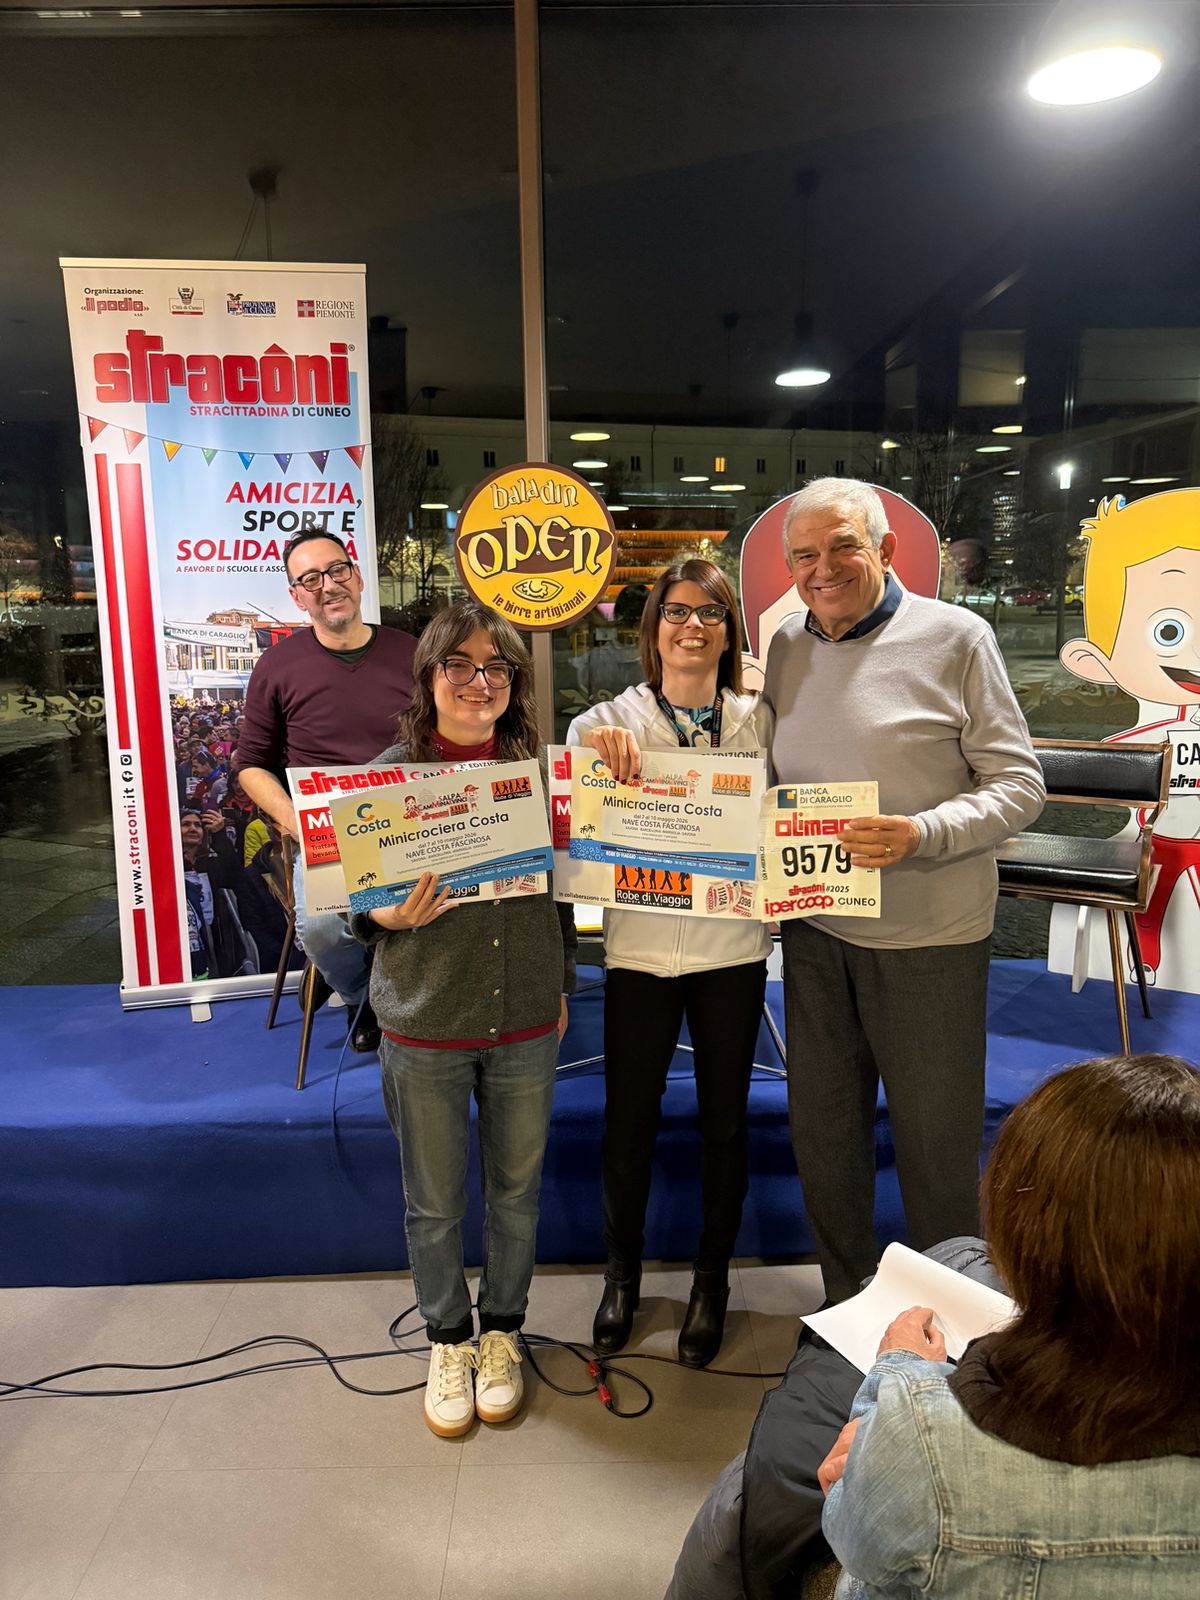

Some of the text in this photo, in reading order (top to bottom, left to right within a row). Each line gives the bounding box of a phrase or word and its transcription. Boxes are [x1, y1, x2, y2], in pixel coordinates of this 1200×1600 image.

[84, 287, 144, 296] Organizzazione:
[316, 300, 355, 310] REGIONE
[316, 310, 356, 319] PIEMONTE
[190, 406, 351, 418] STRACITTADINA DI CUNEO
[225, 482, 363, 509] AMICIZIA,
[490, 478, 580, 511] baladin
[243, 510, 356, 532] SPORT E
[176, 533, 359, 561] SOLIDAÀ
[227, 565, 258, 573] SCUOLE
[492, 590, 587, 620] le birre artigianali
[209, 631, 246, 640] CARAGLIO
[581, 774, 617, 789] Costa
[800, 787, 828, 795] BANCA
[602, 795, 722, 817] Minicrociera Costa
[800, 795, 853, 804] DI CARAGLIO
[346, 818, 392, 836] Costa
[378, 812, 509, 849] Minicrociera Costa
[622, 818, 701, 832] NAVE COSTA FASCINOSA
[309, 834, 328, 842] Con
[444, 835, 464, 844] maggio
[405, 847, 426, 860] NAVE
[426, 843, 451, 854] COSTA
[451, 834, 492, 850] FASCINOSA
[781, 843, 852, 877] 9579
[448, 885, 478, 897] aggio
[826, 885, 850, 893] #2025
[564, 892, 599, 902] collaborazione
[616, 890, 691, 908] Robe di Viaggio
[764, 895, 834, 917] ipercoop
[838, 897, 876, 907] CUNEO
